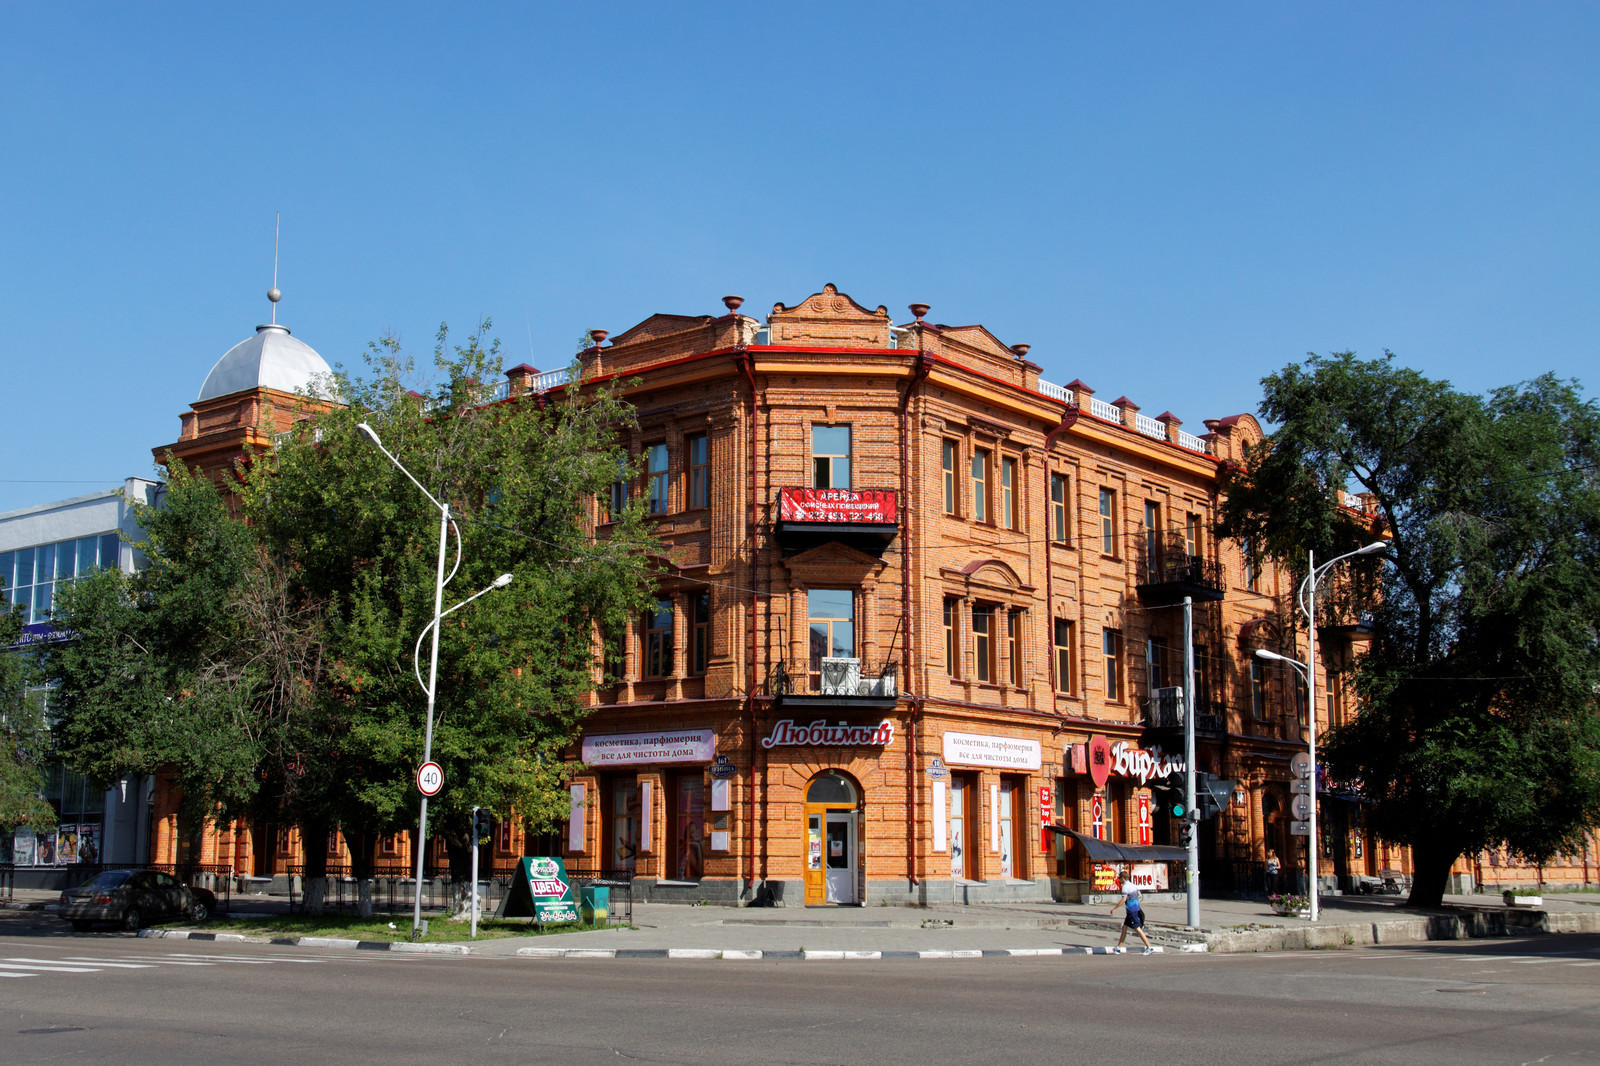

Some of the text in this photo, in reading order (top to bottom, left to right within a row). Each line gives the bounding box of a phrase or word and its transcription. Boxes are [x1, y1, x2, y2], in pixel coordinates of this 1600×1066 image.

[820, 492, 860, 502] АРЕНДА
[800, 502, 835, 510] ОФИСНЫХ
[762, 720, 894, 748] Любимый
[594, 735, 702, 748] косметика, парфюмерия
[953, 738, 1033, 753] косметика, парфюмерия
[616, 752, 632, 760] для
[633, 750, 670, 759] чистоты
[671, 748, 694, 758] дома
[984, 754, 1011, 763] чистоты
[423, 772, 438, 785] 40
[533, 881, 564, 894] ЦВЕТЫ
